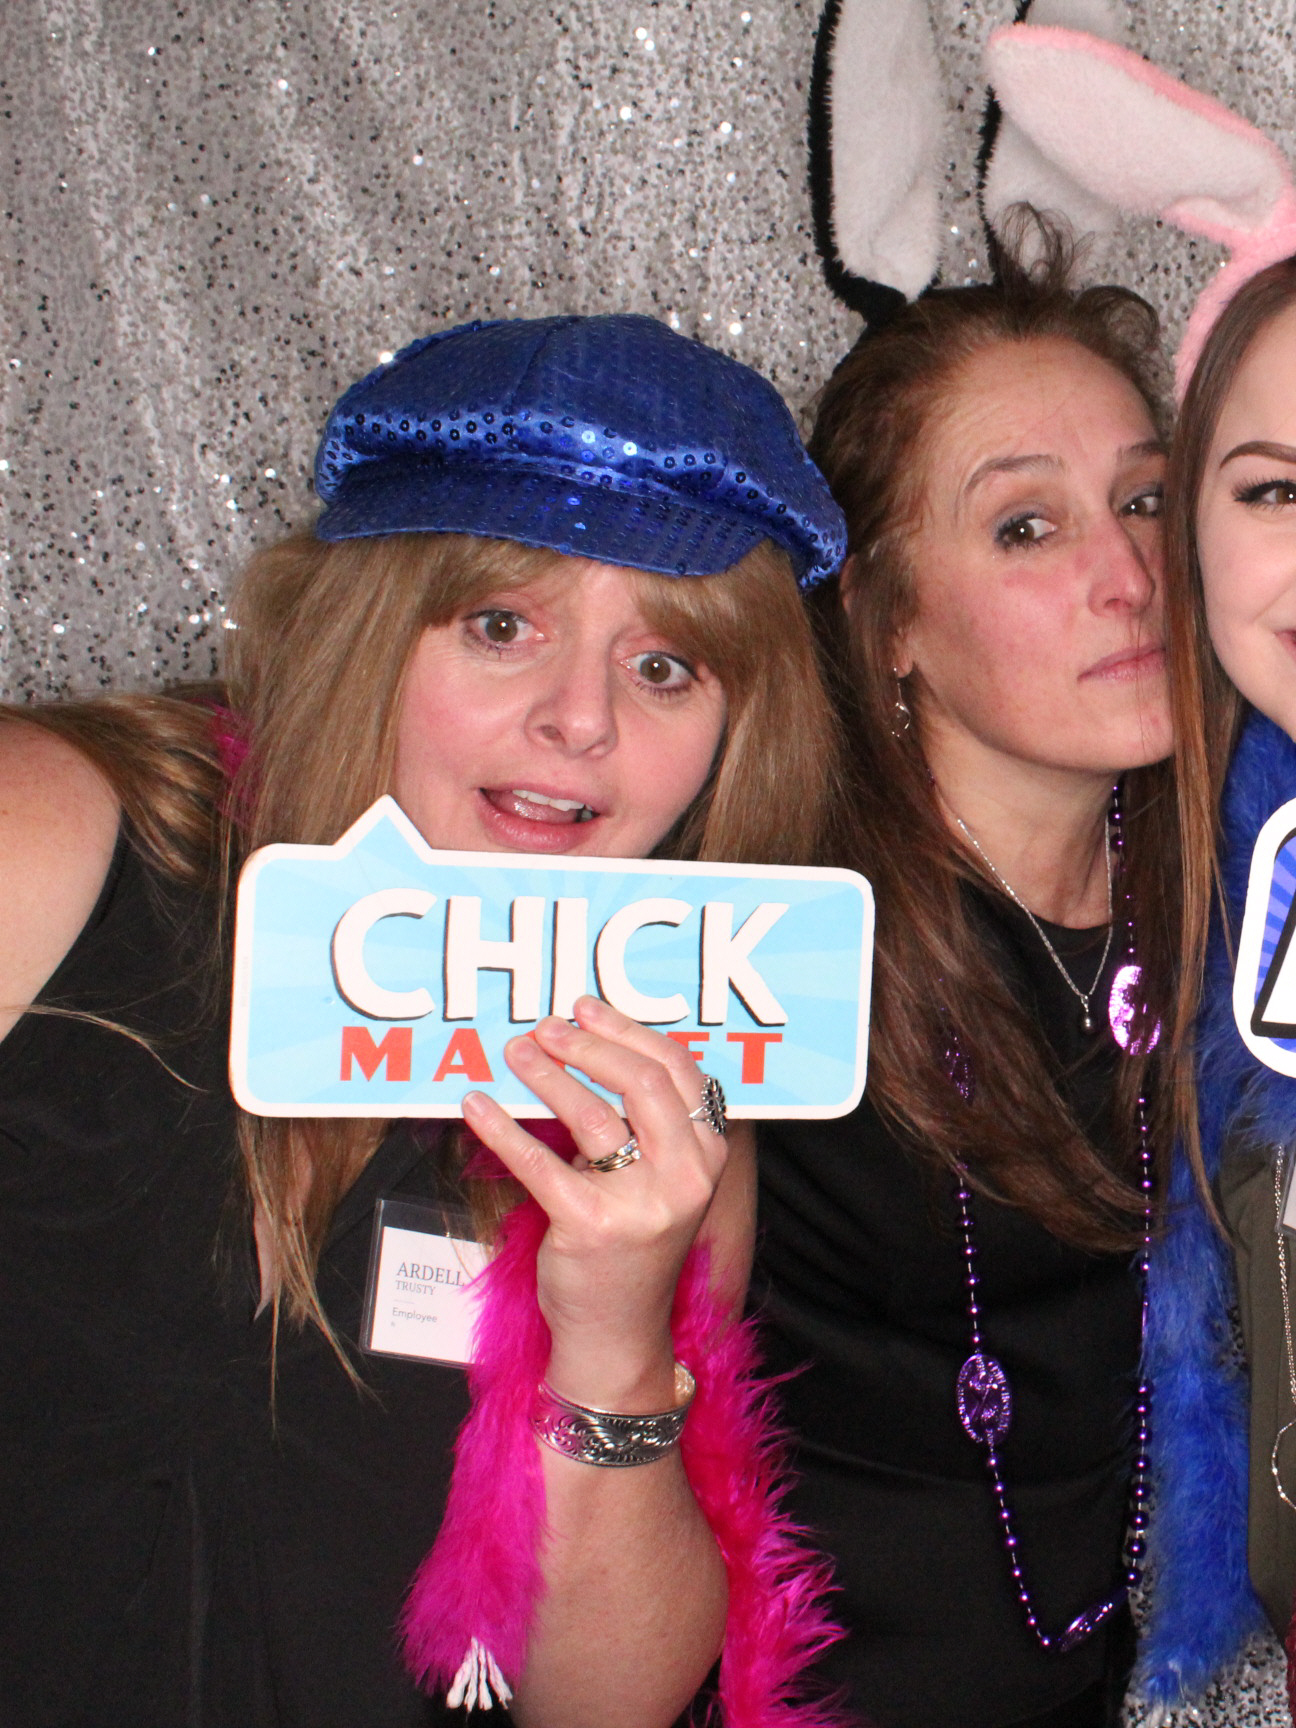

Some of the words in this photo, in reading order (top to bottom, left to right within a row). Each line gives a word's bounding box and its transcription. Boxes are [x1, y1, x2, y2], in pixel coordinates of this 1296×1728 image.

[330, 887, 791, 1026] CHICK
[396, 1261, 465, 1288] ARDELL
[395, 1279, 437, 1296] TRUSTY
[391, 1306, 438, 1323] Employee
